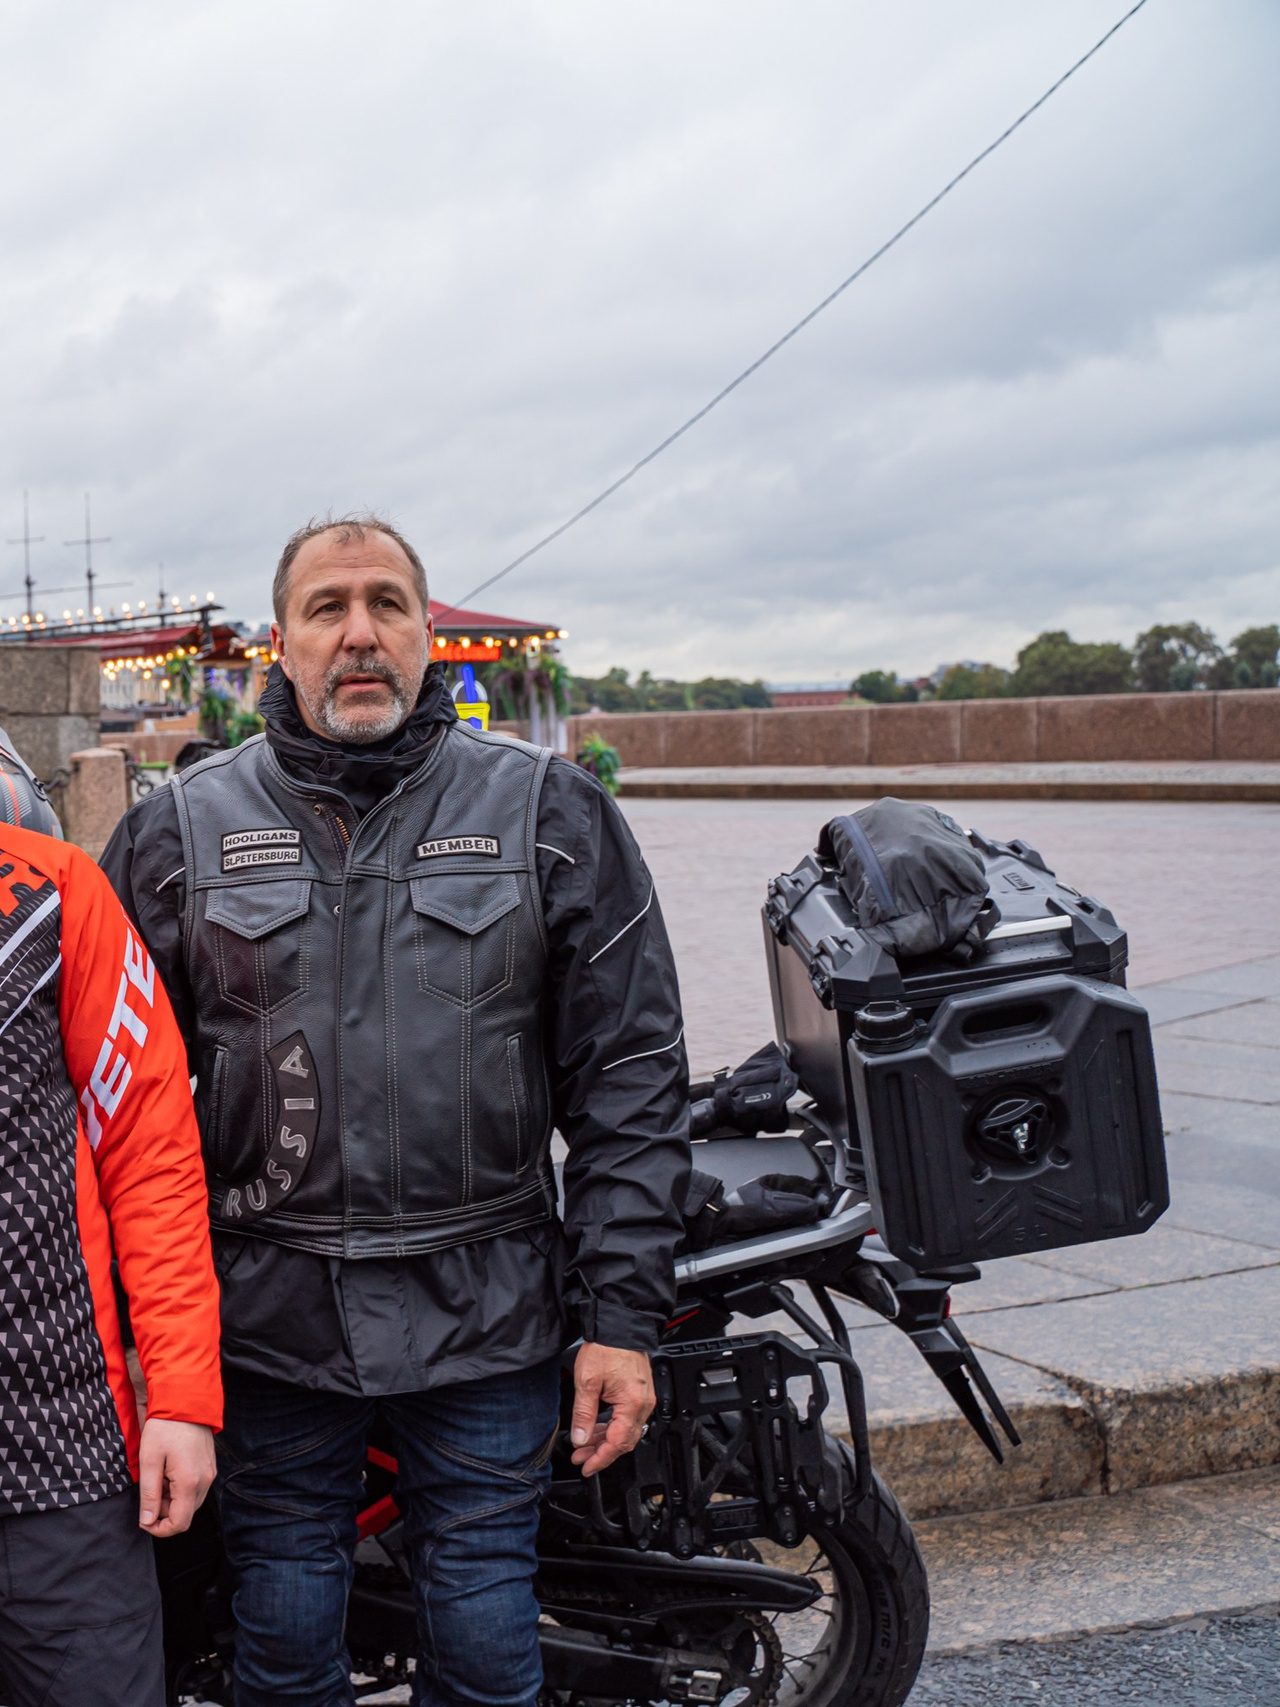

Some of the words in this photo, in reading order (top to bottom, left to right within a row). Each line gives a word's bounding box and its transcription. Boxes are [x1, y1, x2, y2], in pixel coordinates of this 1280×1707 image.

[224, 832, 297, 848] HOOLIGANS
[422, 839, 495, 855] MEMBER
[226, 1045, 316, 1218] RUSSIA
